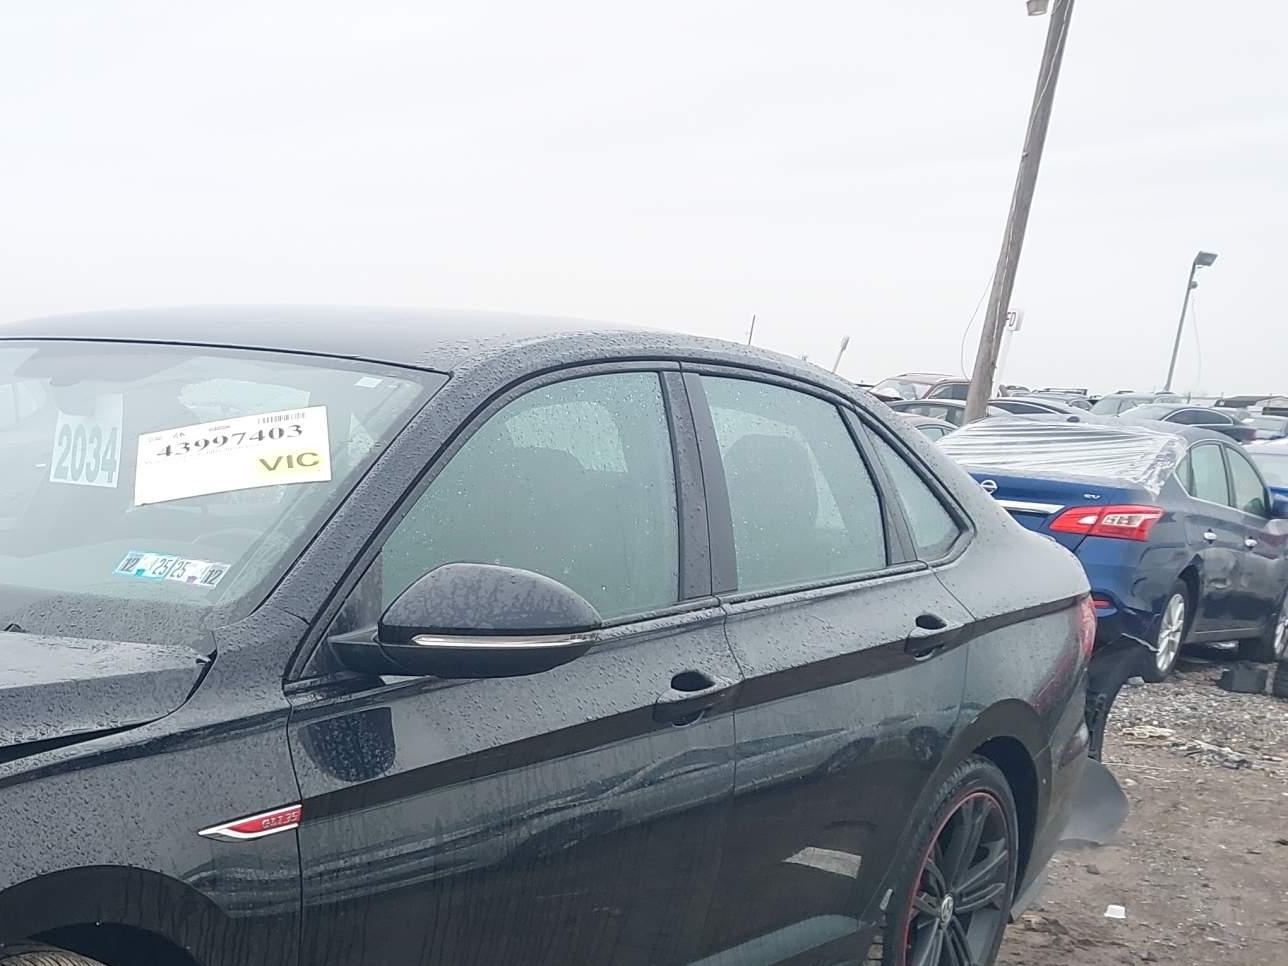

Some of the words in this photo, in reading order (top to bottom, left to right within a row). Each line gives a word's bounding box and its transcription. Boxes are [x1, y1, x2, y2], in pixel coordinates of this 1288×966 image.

[53, 424, 118, 483] 2034
[156, 424, 303, 457] 43997403
[259, 452, 320, 471] VIC
[152, 558, 174, 576] 25
